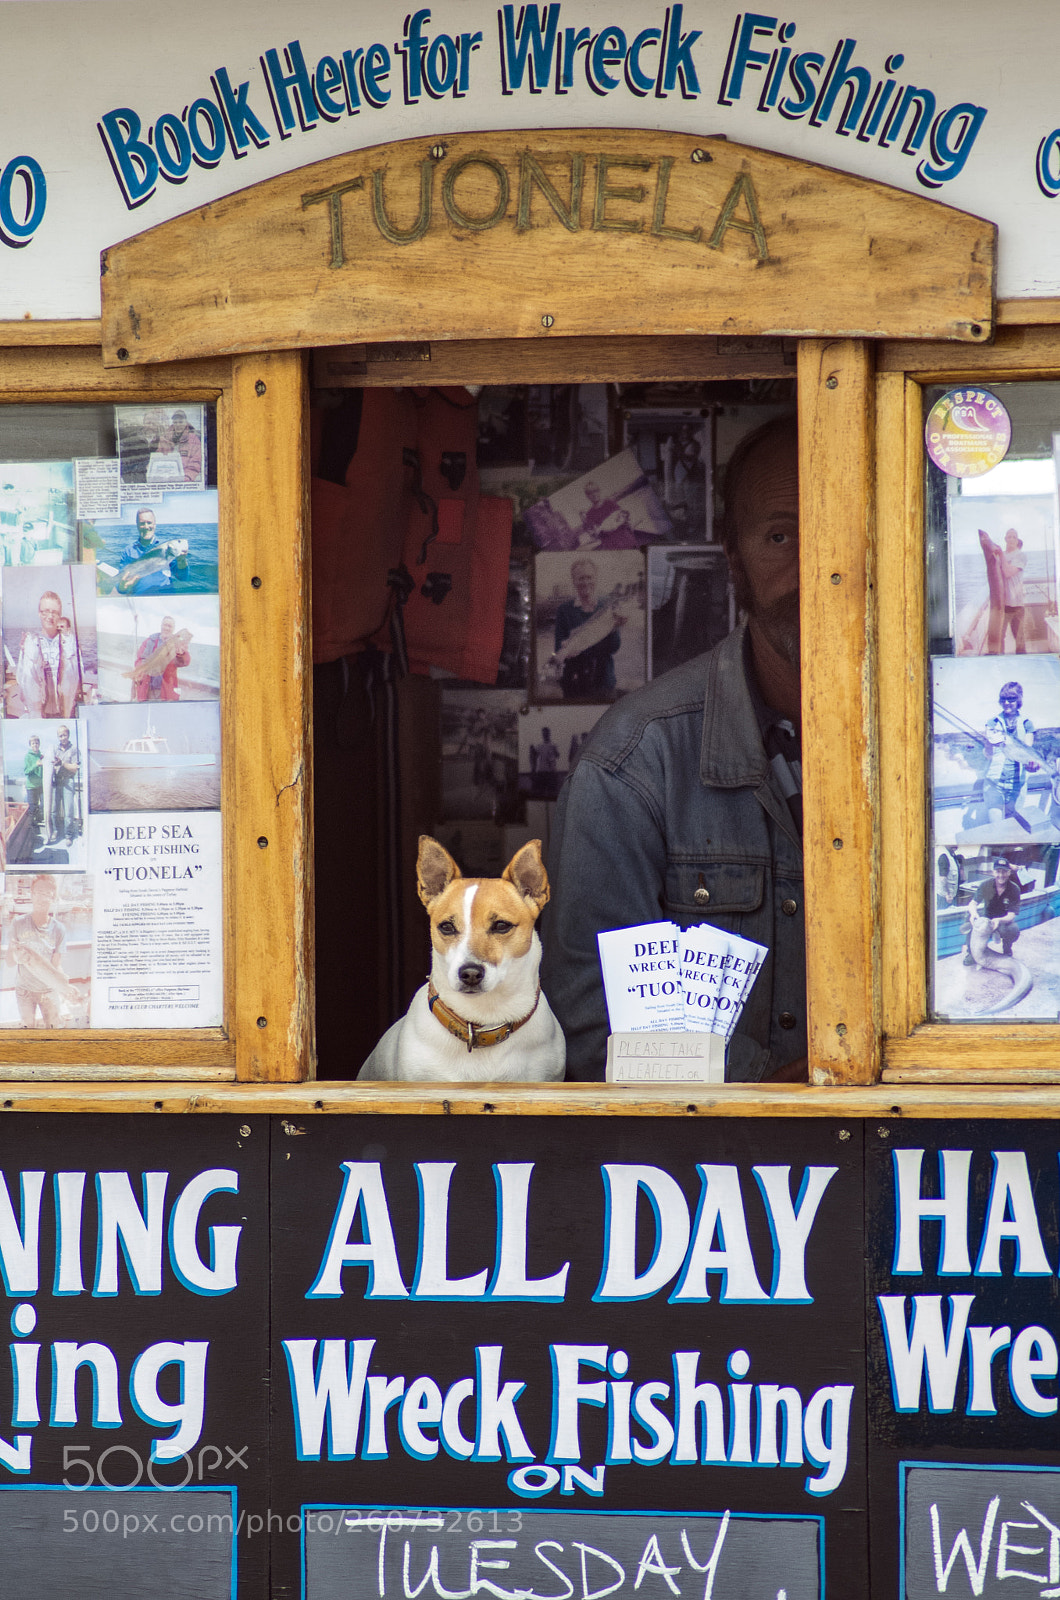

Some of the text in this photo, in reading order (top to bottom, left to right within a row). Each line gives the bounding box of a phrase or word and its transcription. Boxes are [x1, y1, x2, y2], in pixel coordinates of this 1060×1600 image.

[97, 66, 271, 211] Book
[260, 40, 392, 140] Here
[394, 8, 483, 105] for
[498, 3, 702, 99] Wreck
[716, 12, 988, 188] Fishing
[301, 151, 771, 270] TUONELA
[934, 391, 1003, 420] RESPECT
[113, 824, 194, 841] DEEP SEA
[107, 843, 200, 856] WRECK FISHING
[629, 959, 676, 973] WRECK
[619, 1040, 704, 1057] PLEASE TAKE
[618, 1065, 624, 1079] A
[305, 1161, 839, 1304] ALL DAY
[282, 1339, 854, 1497] Wreck Fishing
[507, 1465, 605, 1498] ON
[345, 1509, 731, 1600] TUESDAY
